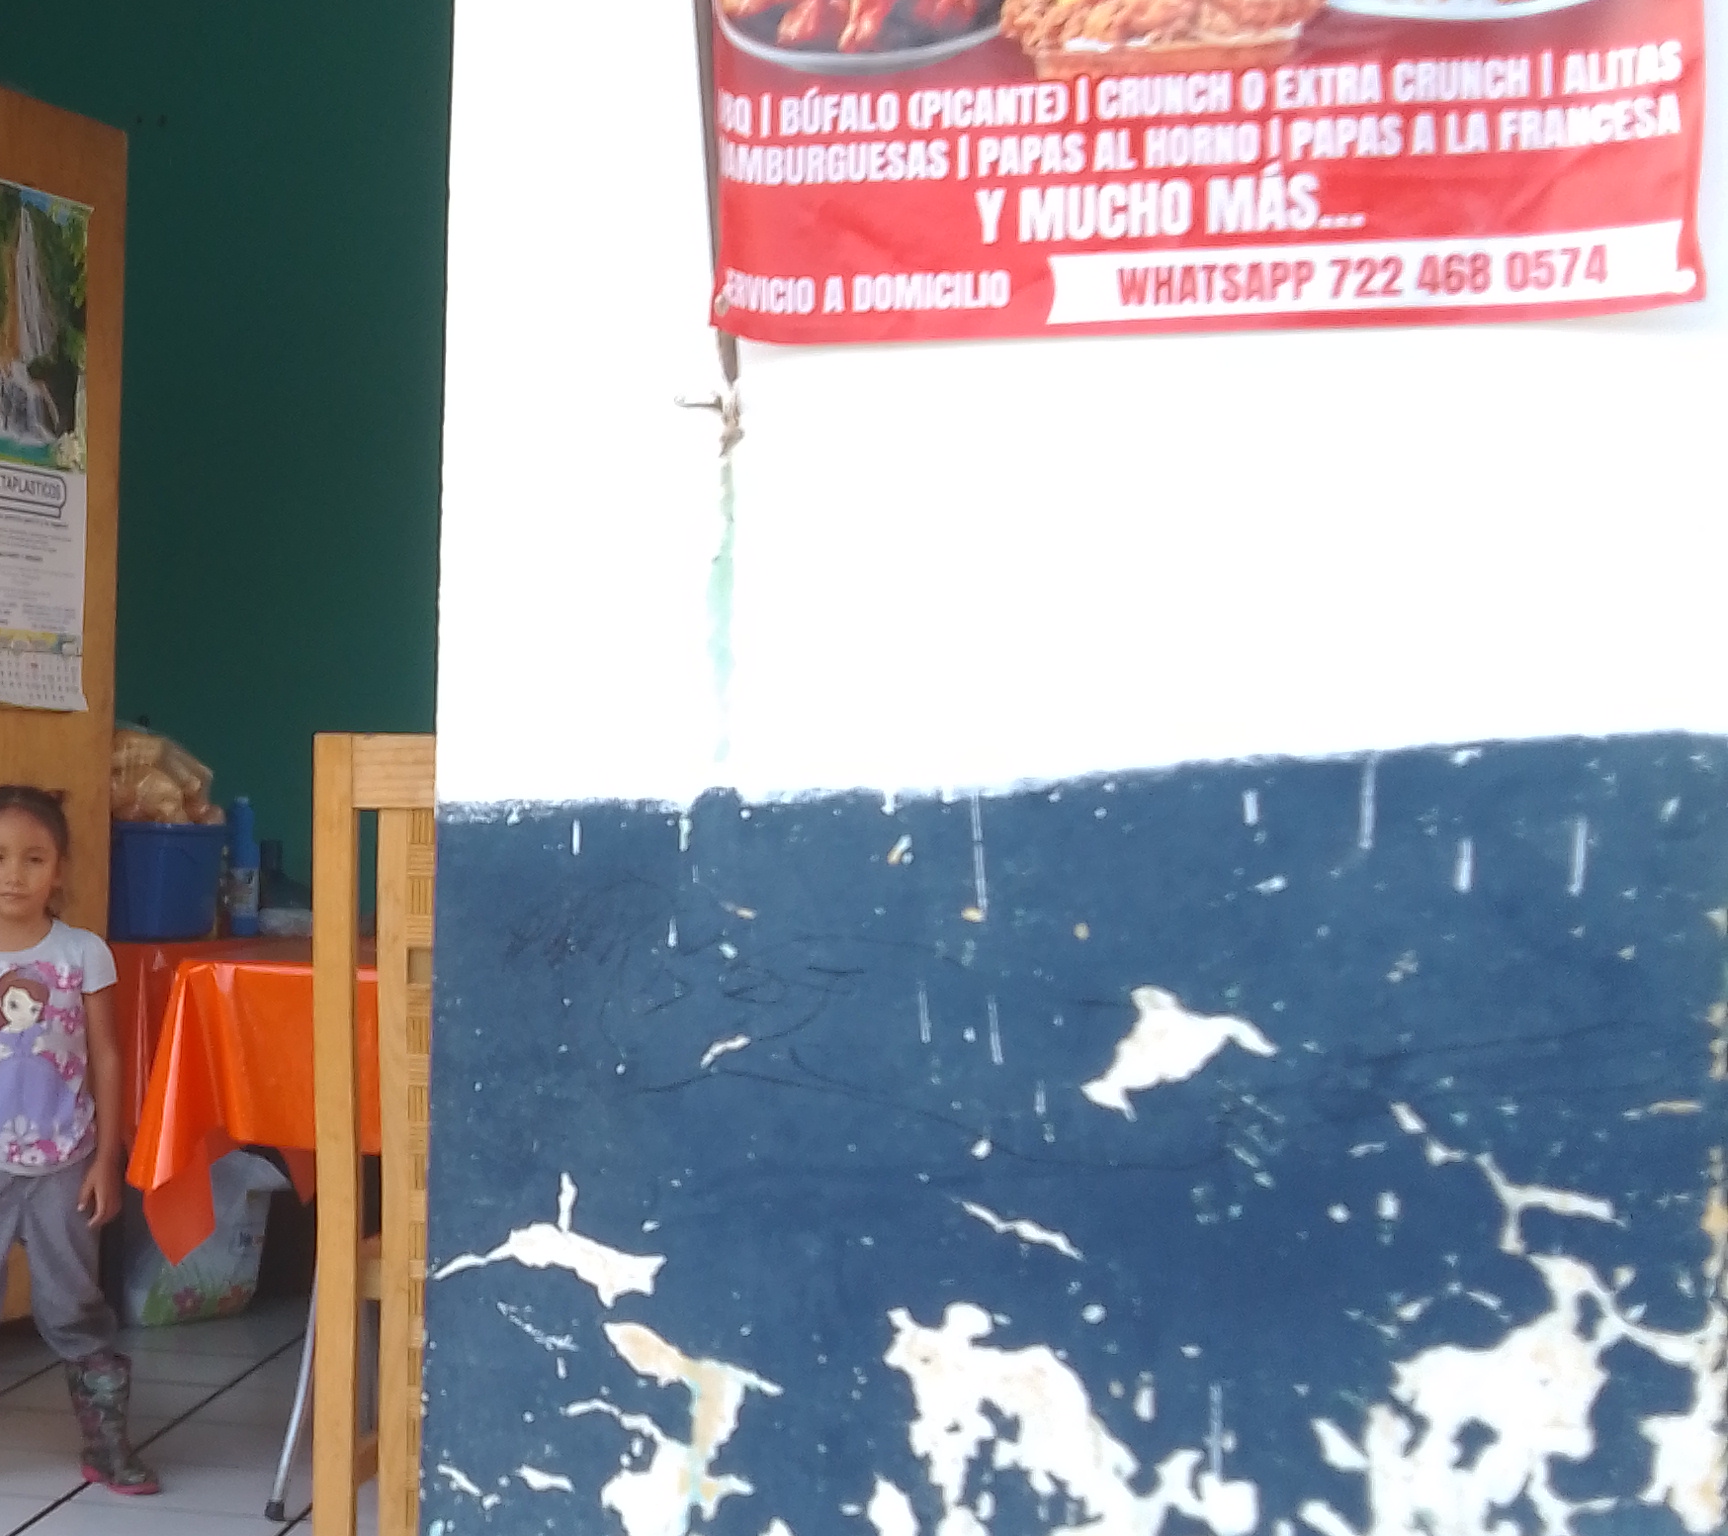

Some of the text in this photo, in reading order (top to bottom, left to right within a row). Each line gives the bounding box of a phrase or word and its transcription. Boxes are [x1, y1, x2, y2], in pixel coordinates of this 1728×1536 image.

[779, 85, 900, 137] BÚFALO
[908, 81, 1070, 131] (PICANTE)
[1096, 70, 1233, 120] CRUNCH
[1240, 67, 1267, 112] O
[1274, 62, 1382, 109] EXTRA
[1393, 57, 1531, 103] CRUNCH
[1561, 40, 1683, 95] ALITAS
[977, 131, 1086, 178] PAPAS
[1093, 127, 1138, 172] AL
[1144, 120, 1262, 170] HORNO
[1288, 113, 1404, 162] PAPAS
[1409, 112, 1436, 157] A
[1444, 110, 1490, 156] LA
[1497, 92, 1682, 153] FRANCESA
[974, 163, 1367, 245] Y MUCHO MÁS...
[823, 273, 846, 314] A
[852, 269, 1012, 313] DOMICILIO
[1116, 259, 1317, 307] WHATSAPP
[1328, 255, 1404, 300] 722
[1415, 252, 1491, 295] 468
[1504, 243, 1609, 290] 0574
